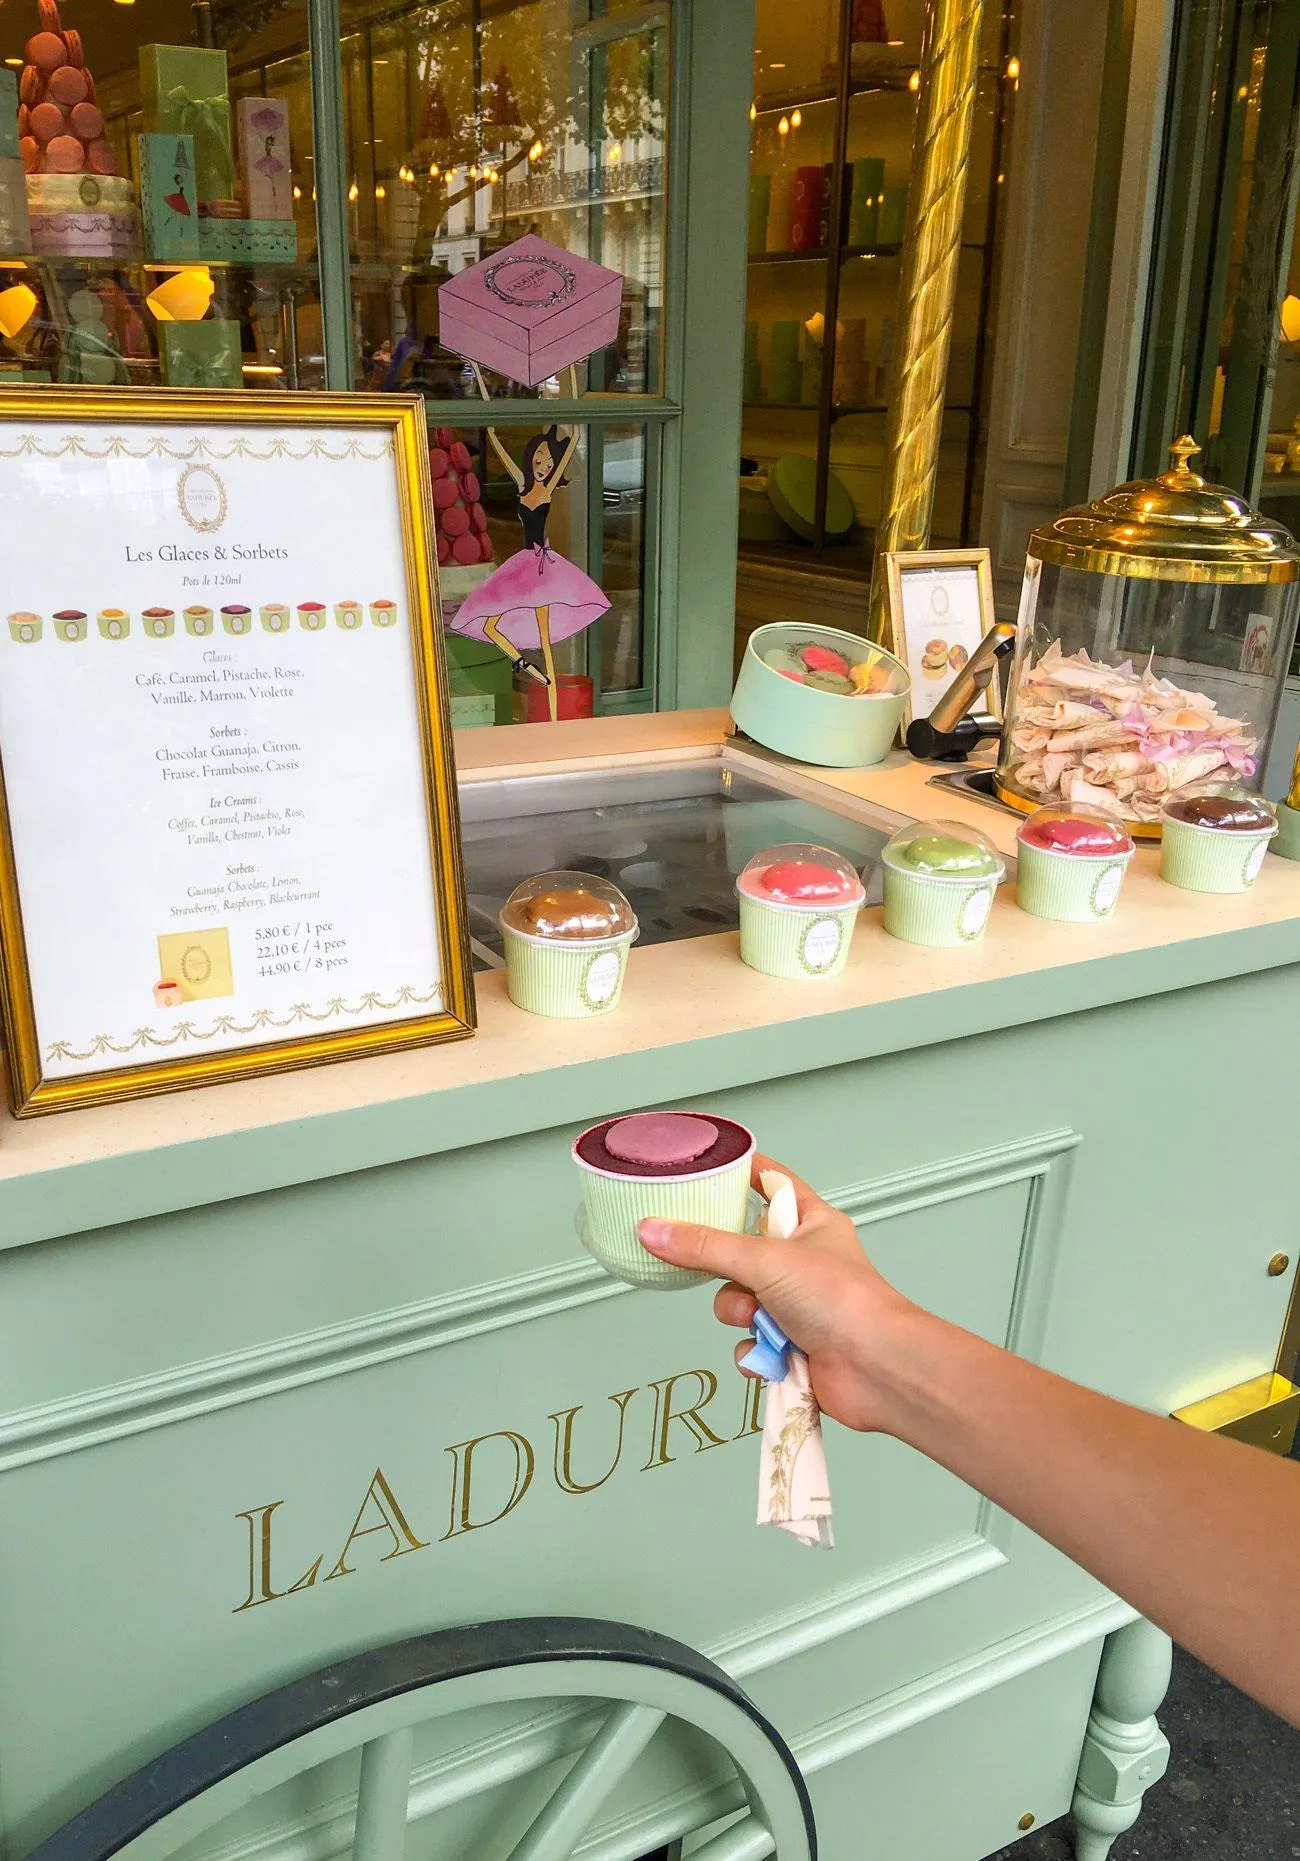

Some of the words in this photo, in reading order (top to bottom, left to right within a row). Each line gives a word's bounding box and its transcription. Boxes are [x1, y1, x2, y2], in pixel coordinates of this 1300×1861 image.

[125, 545, 153, 562] Les
[158, 544, 210, 562] Glaces
[214, 545, 228, 560] &
[232, 543, 288, 560] Sorbets
[182, 576, 200, 587] Pots
[202, 575, 210, 586] de
[214, 574, 242, 586] 120ml
[202, 650, 232, 663] Glaces
[135, 672, 166, 686] Café,
[169, 670, 220, 685] Caramel,
[222, 668, 272, 682] Pistache,
[274, 666, 305, 678] Rose,
[151, 692, 197, 705] Vanille,
[200, 689, 247, 702] Marron,
[250, 686, 294, 699] Violette
[209, 724, 242, 739] Sorbets
[155, 746, 208, 762] Chocolat
[211, 742, 260, 758] Guanaja,
[262, 740, 301, 753] Citron,
[162, 768, 200, 780] Fraise,
[202, 762, 263, 778] Framboise,
[266, 758, 300, 772] Cassis
[210, 797, 221, 809] Ice
[224, 796, 257, 807] Creams
[168, 818, 198, 832] Coffee,
[200, 812, 240, 827] Caramel,
[243, 808, 282, 823] Pistachio,
[284, 807, 305, 818] Rose,
[187, 832, 221, 845] Vanilla,
[224, 828, 264, 842] Chestnut,
[267, 824, 291, 837] Violet
[226, 862, 255, 876] Sorbets
[186, 884, 224, 898] Guanaja
[227, 878, 269, 893] Chocolate,
[272, 876, 302, 888] Lemon,
[170, 902, 220, 917] Strawberry,
[223, 896, 266, 912] Raspberry,
[269, 890, 320, 905] Blackcurrant
[254, 926, 280, 940] 5.80
[256, 944, 289, 959] 22.10
[314, 940, 320, 950] 4
[315, 957, 322, 968] 8
